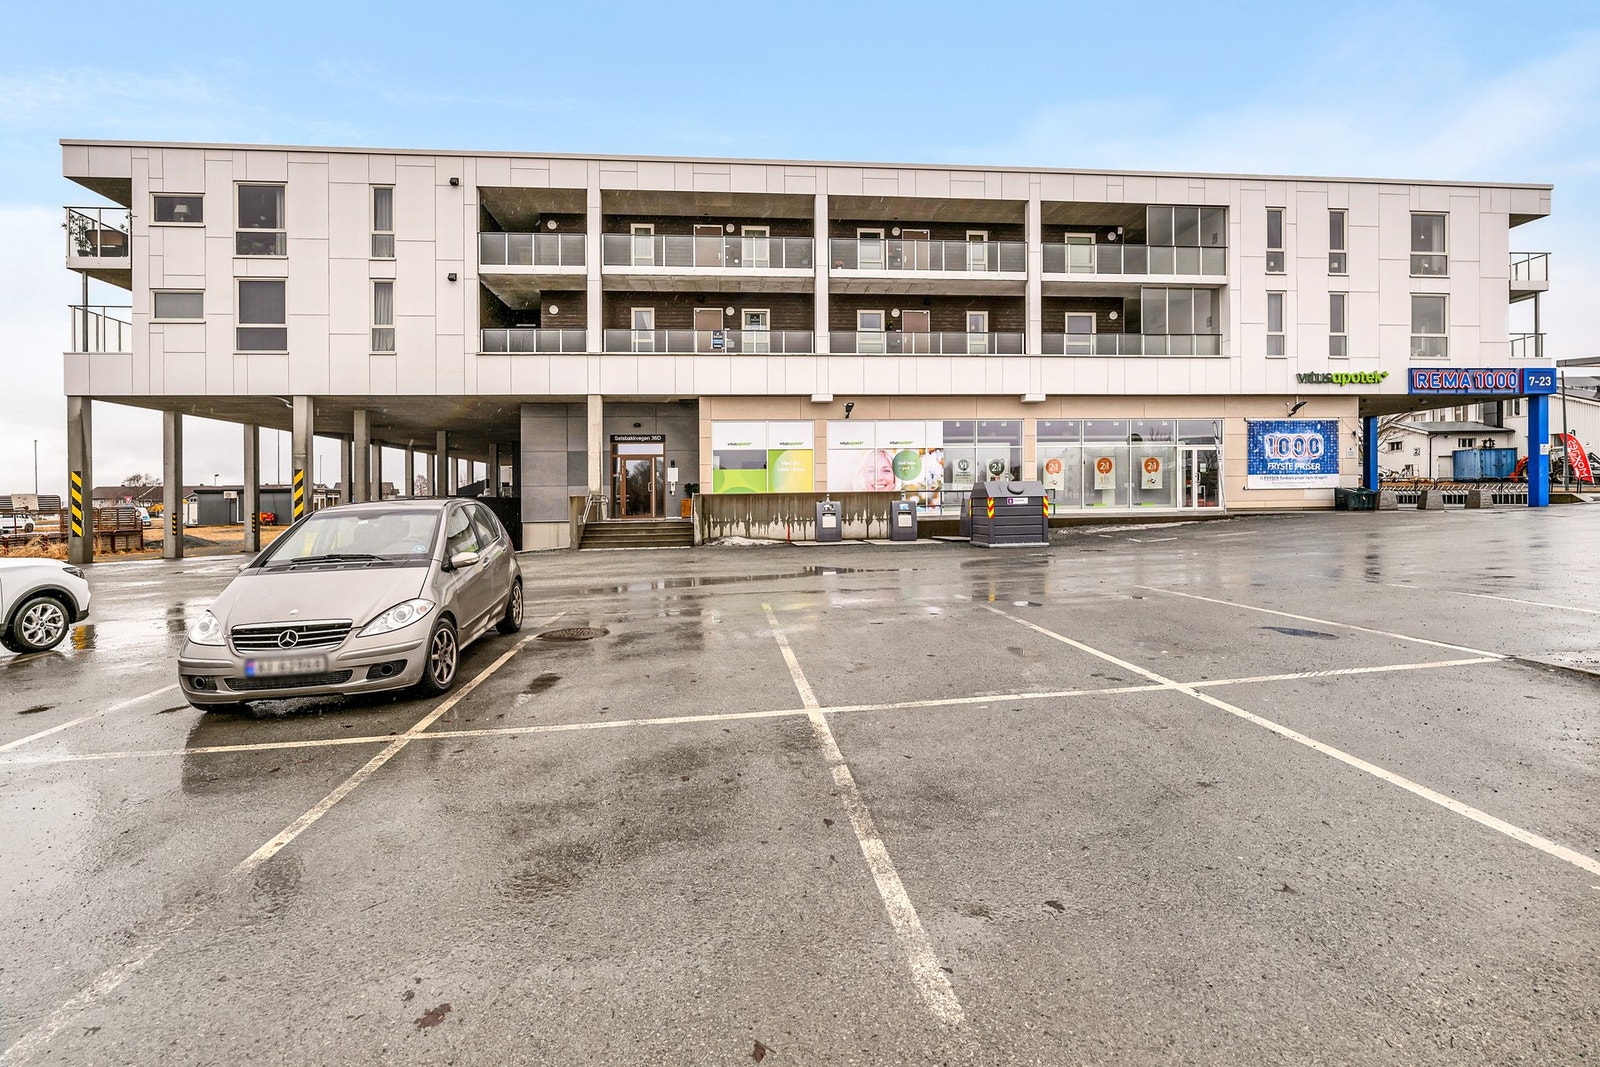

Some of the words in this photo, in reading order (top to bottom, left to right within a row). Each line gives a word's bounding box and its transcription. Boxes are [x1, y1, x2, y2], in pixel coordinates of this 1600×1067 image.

[1296, 370, 1383, 387] vitusapotek
[1413, 371, 1472, 389] REMA
[1474, 371, 1519, 389] 1000
[1528, 376, 1552, 387] 7-23
[1265, 434, 1323, 459] 1000
[1267, 462, 1293, 470] FRYSTE
[1294, 462, 1321, 470] PRISER
